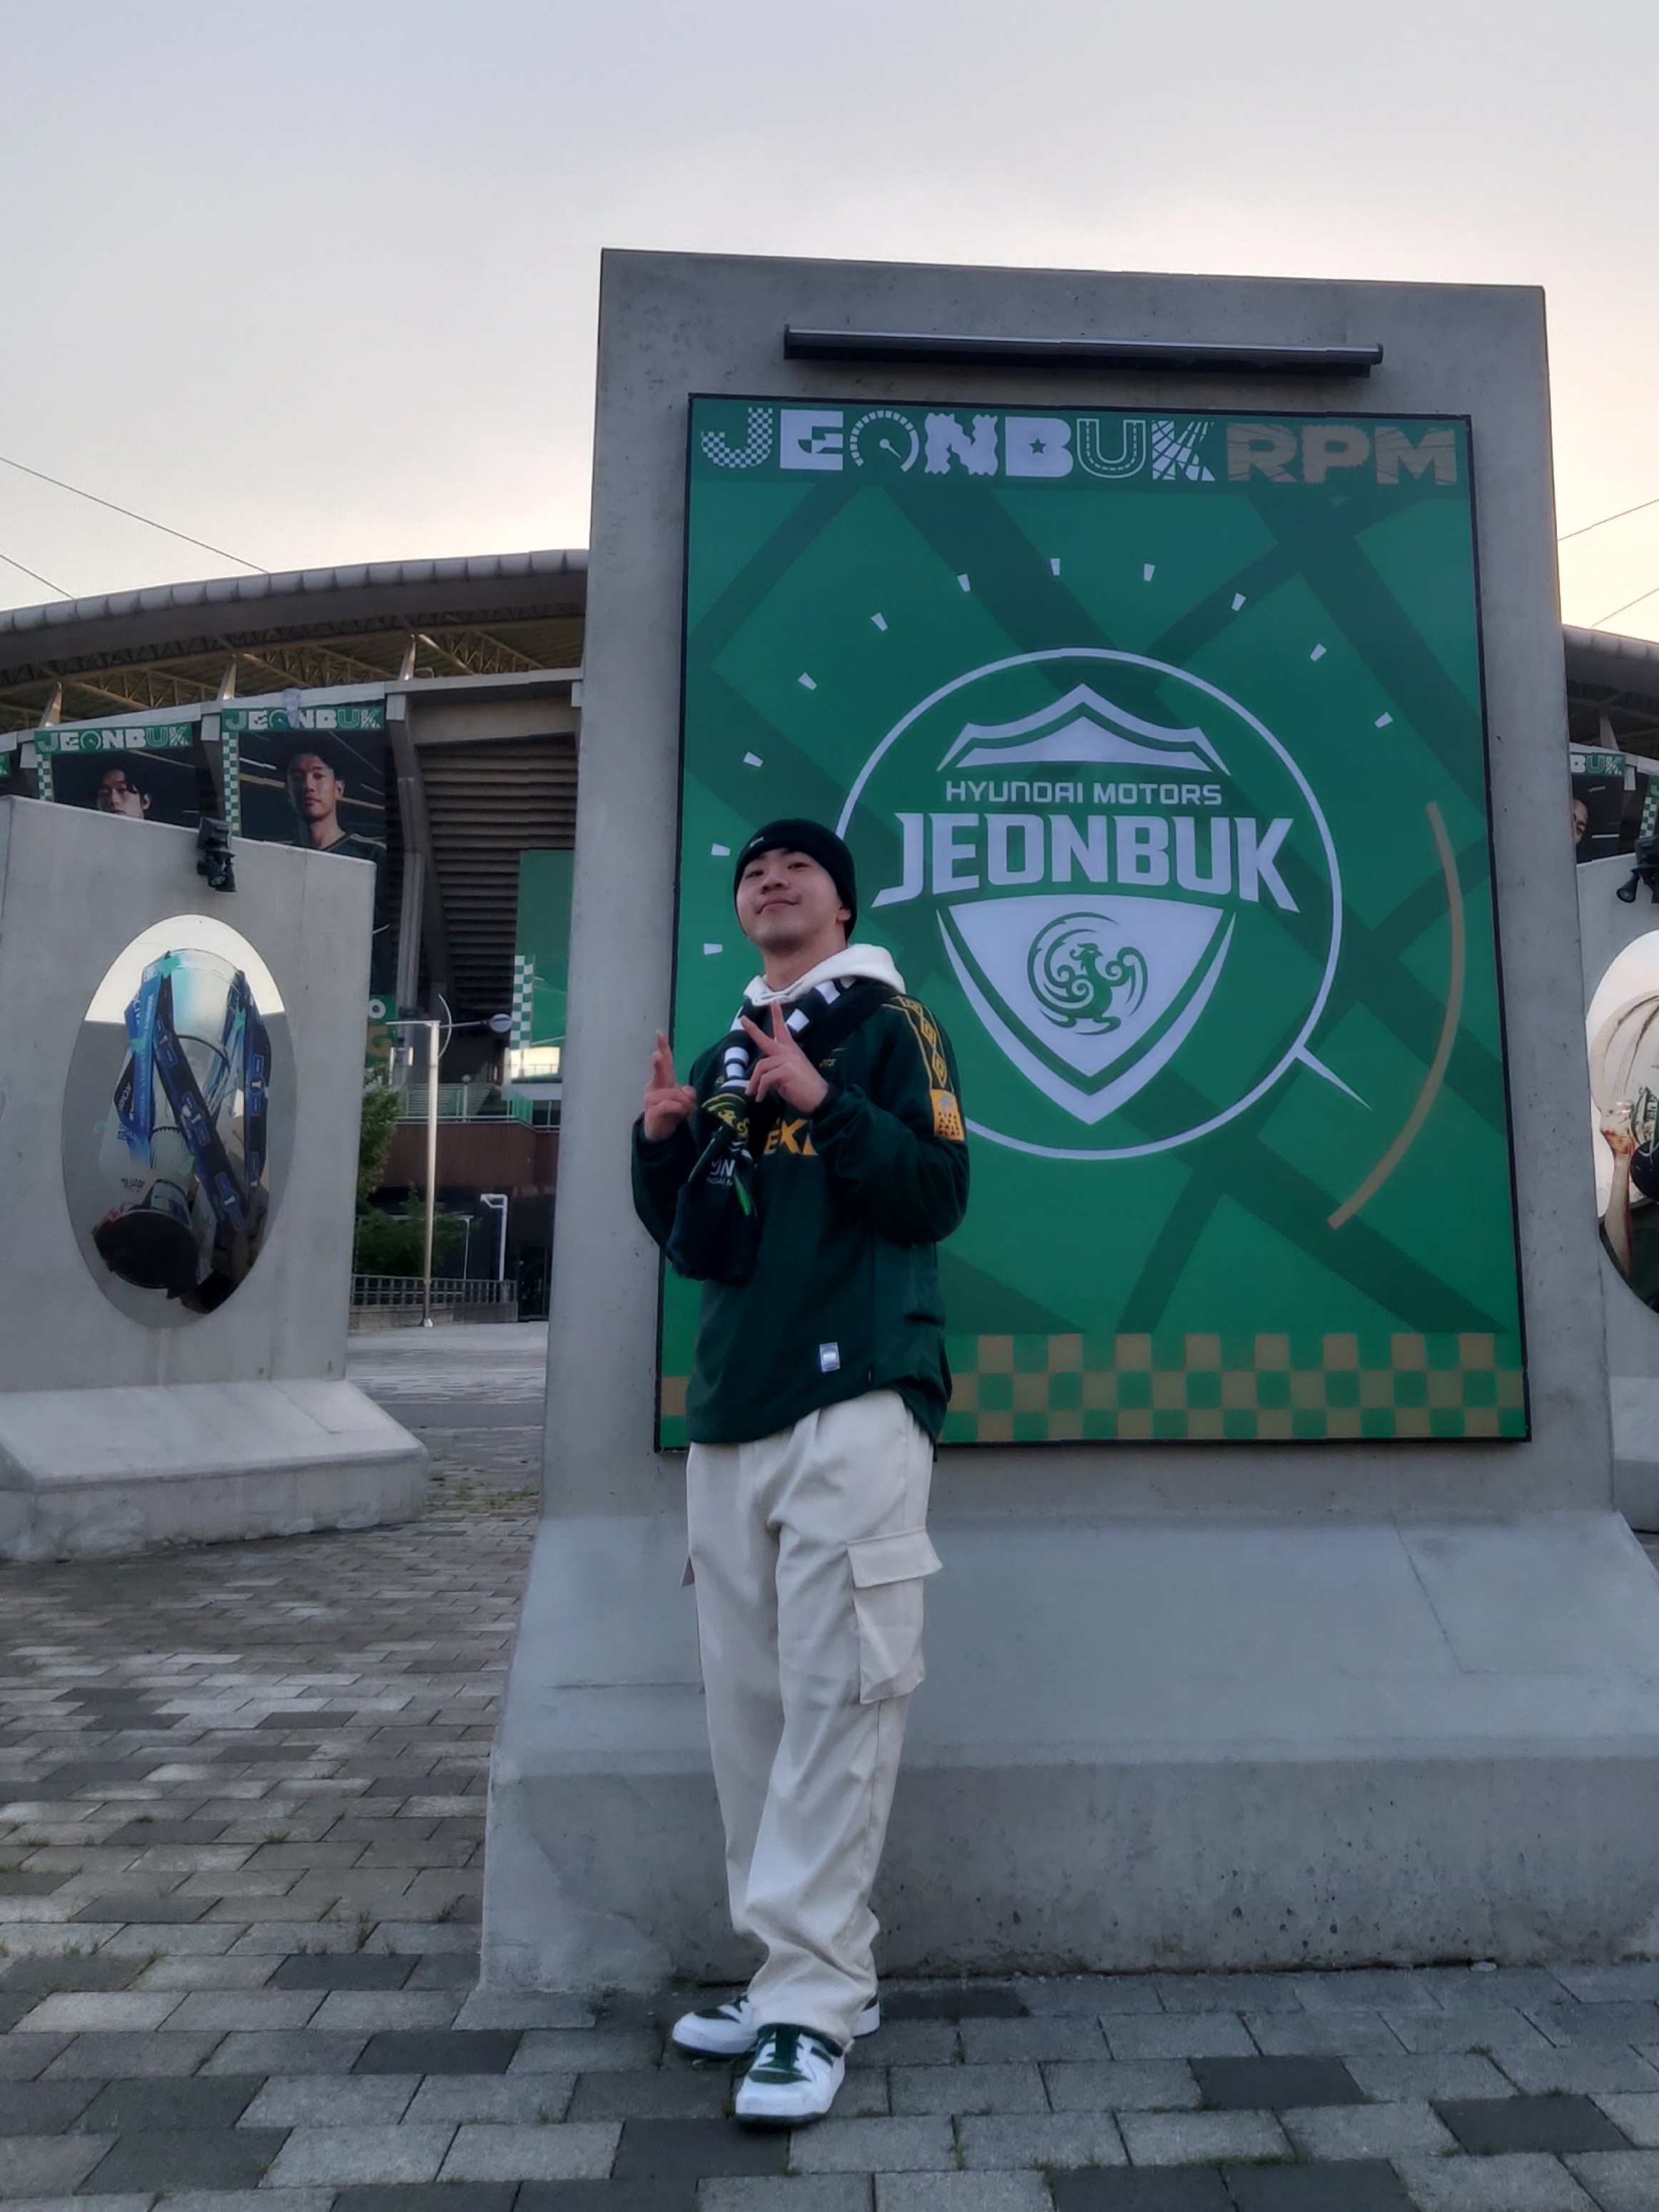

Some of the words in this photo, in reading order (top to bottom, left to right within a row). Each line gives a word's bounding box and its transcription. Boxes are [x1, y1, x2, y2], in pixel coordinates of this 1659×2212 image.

[701, 407, 1215, 481] JEONBUK
[1227, 422, 1458, 486] RPM
[38, 726, 191, 753] JEONBUK
[945, 779, 1083, 804] HYUNDAI
[1093, 782, 1222, 806] MOTORS
[871, 812, 1301, 914] JEONBUK
